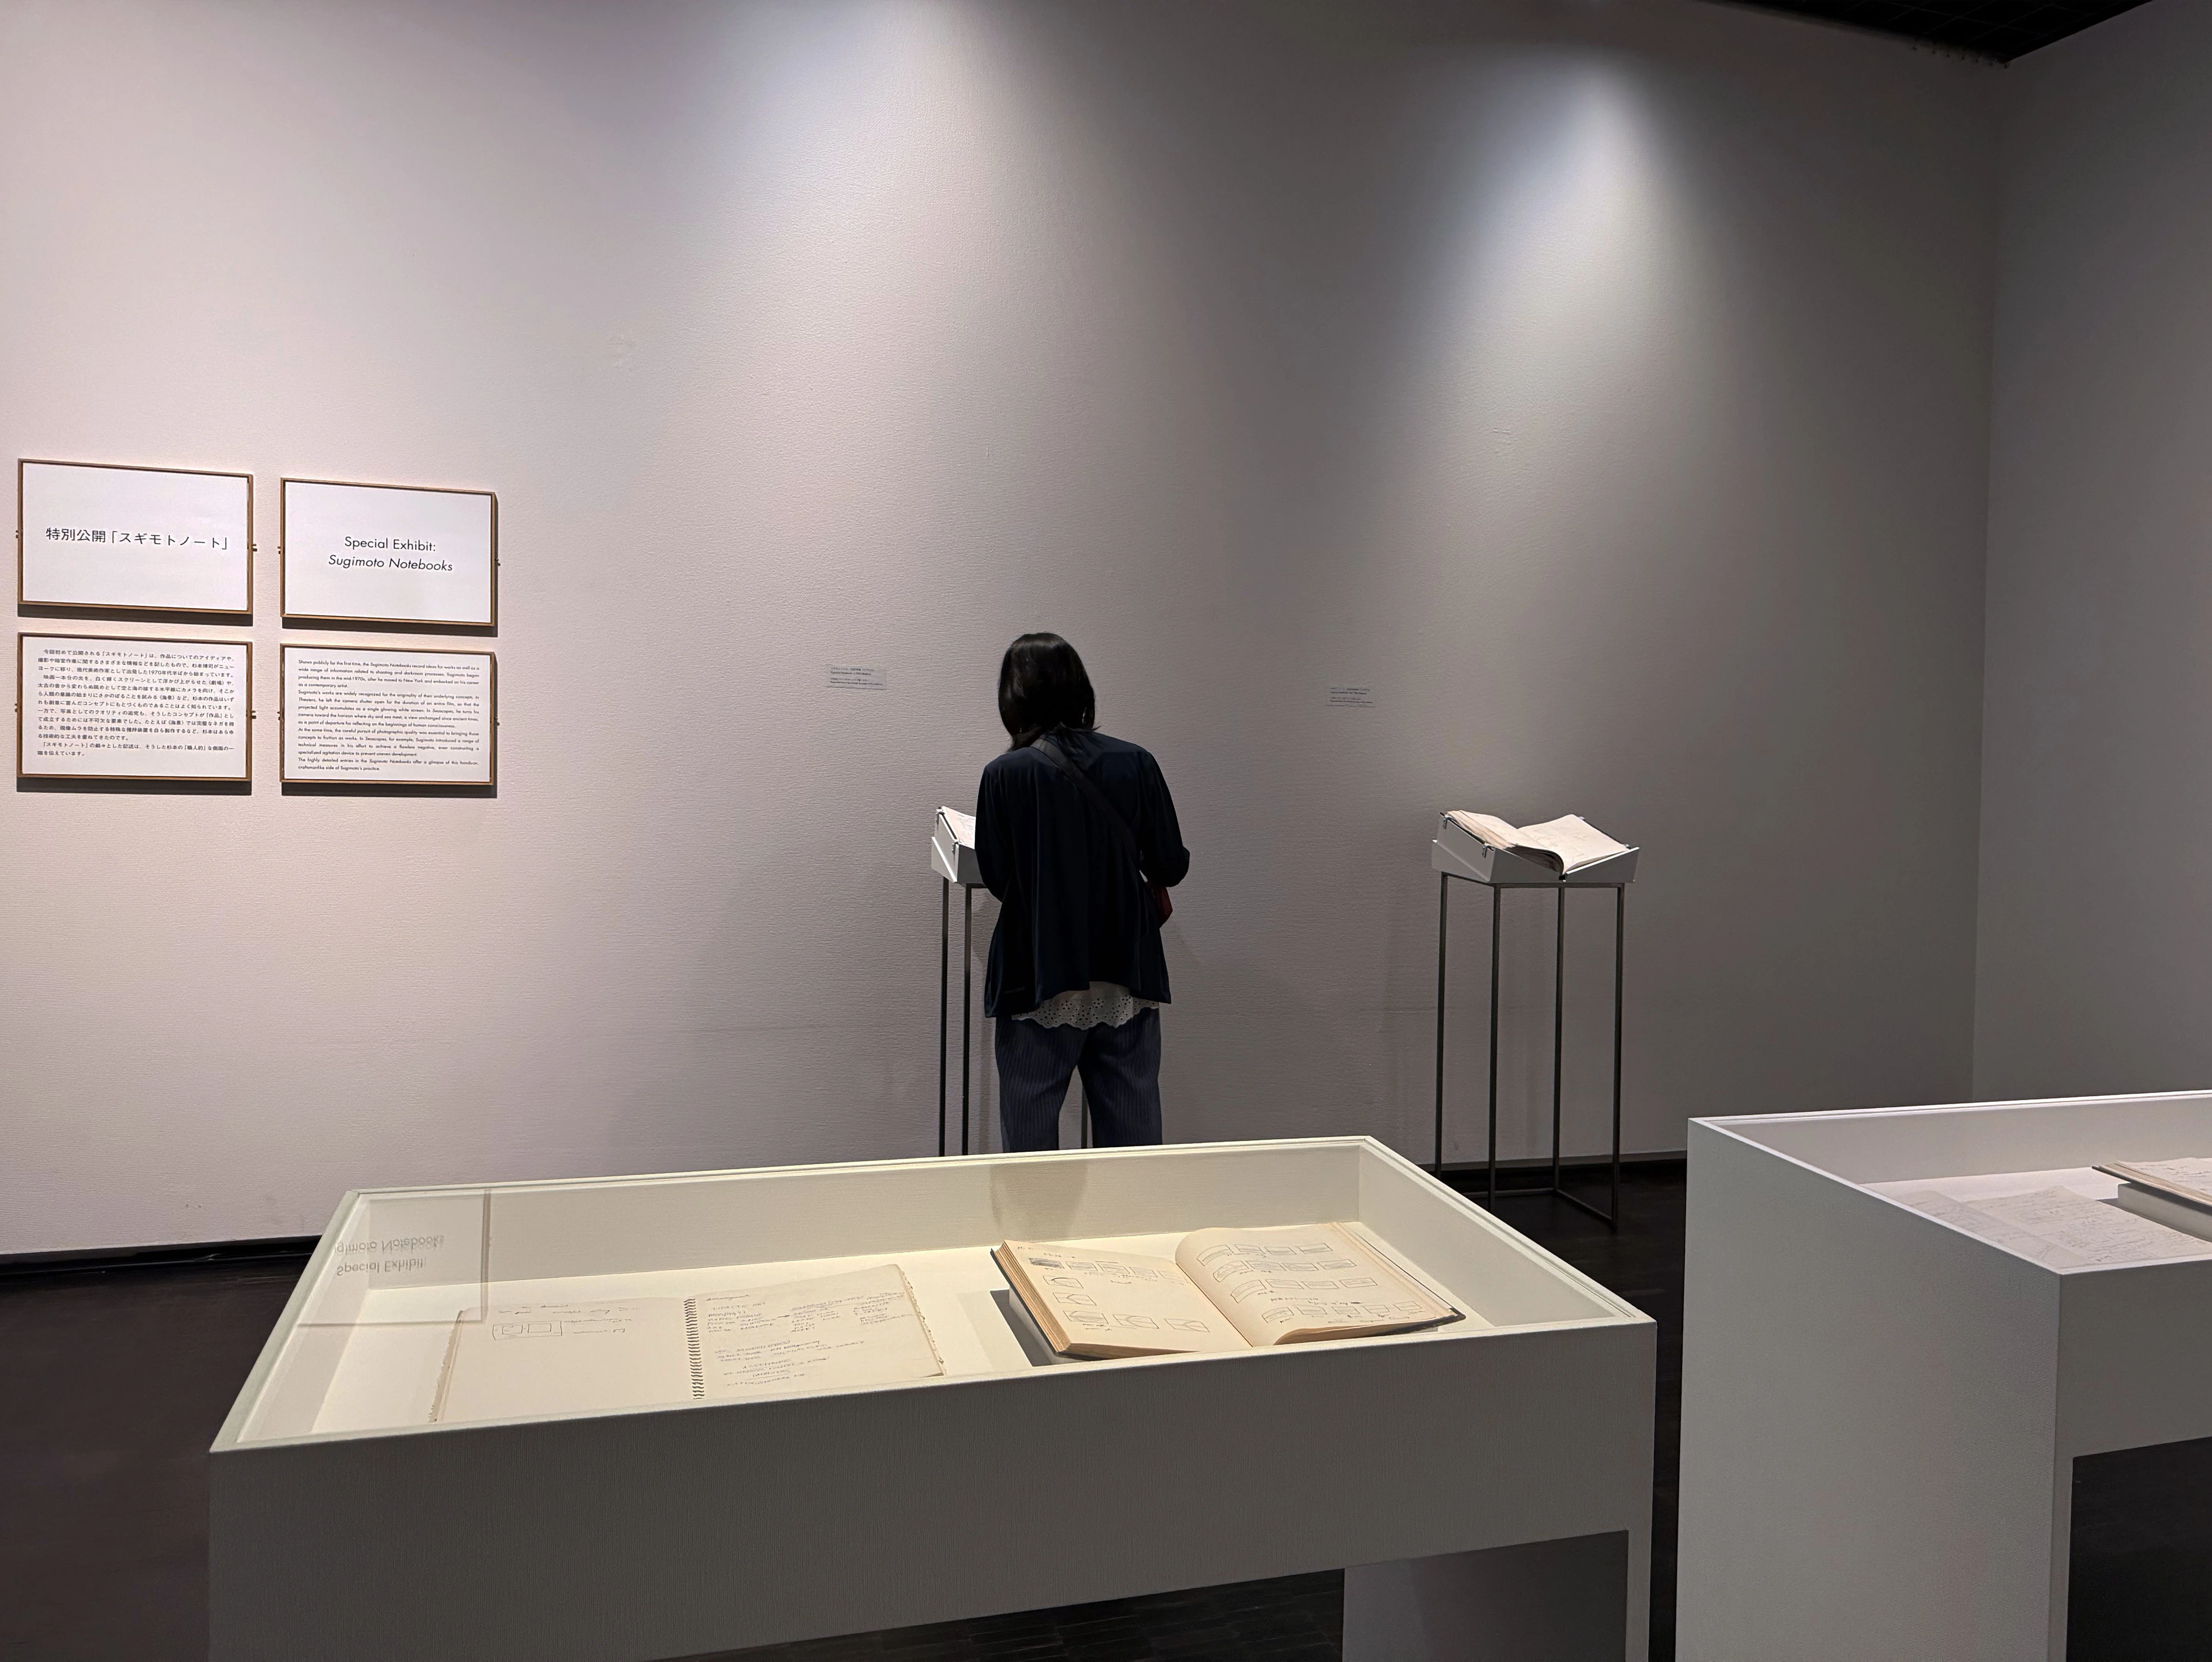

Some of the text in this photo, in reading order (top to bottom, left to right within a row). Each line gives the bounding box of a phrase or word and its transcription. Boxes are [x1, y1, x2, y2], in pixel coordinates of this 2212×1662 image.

[45, 527, 227, 550] 特別公開「スギモトノート」
[344, 536, 436, 552] Special Exhibit:
[328, 554, 453, 571] Sugimoto Notebooks
